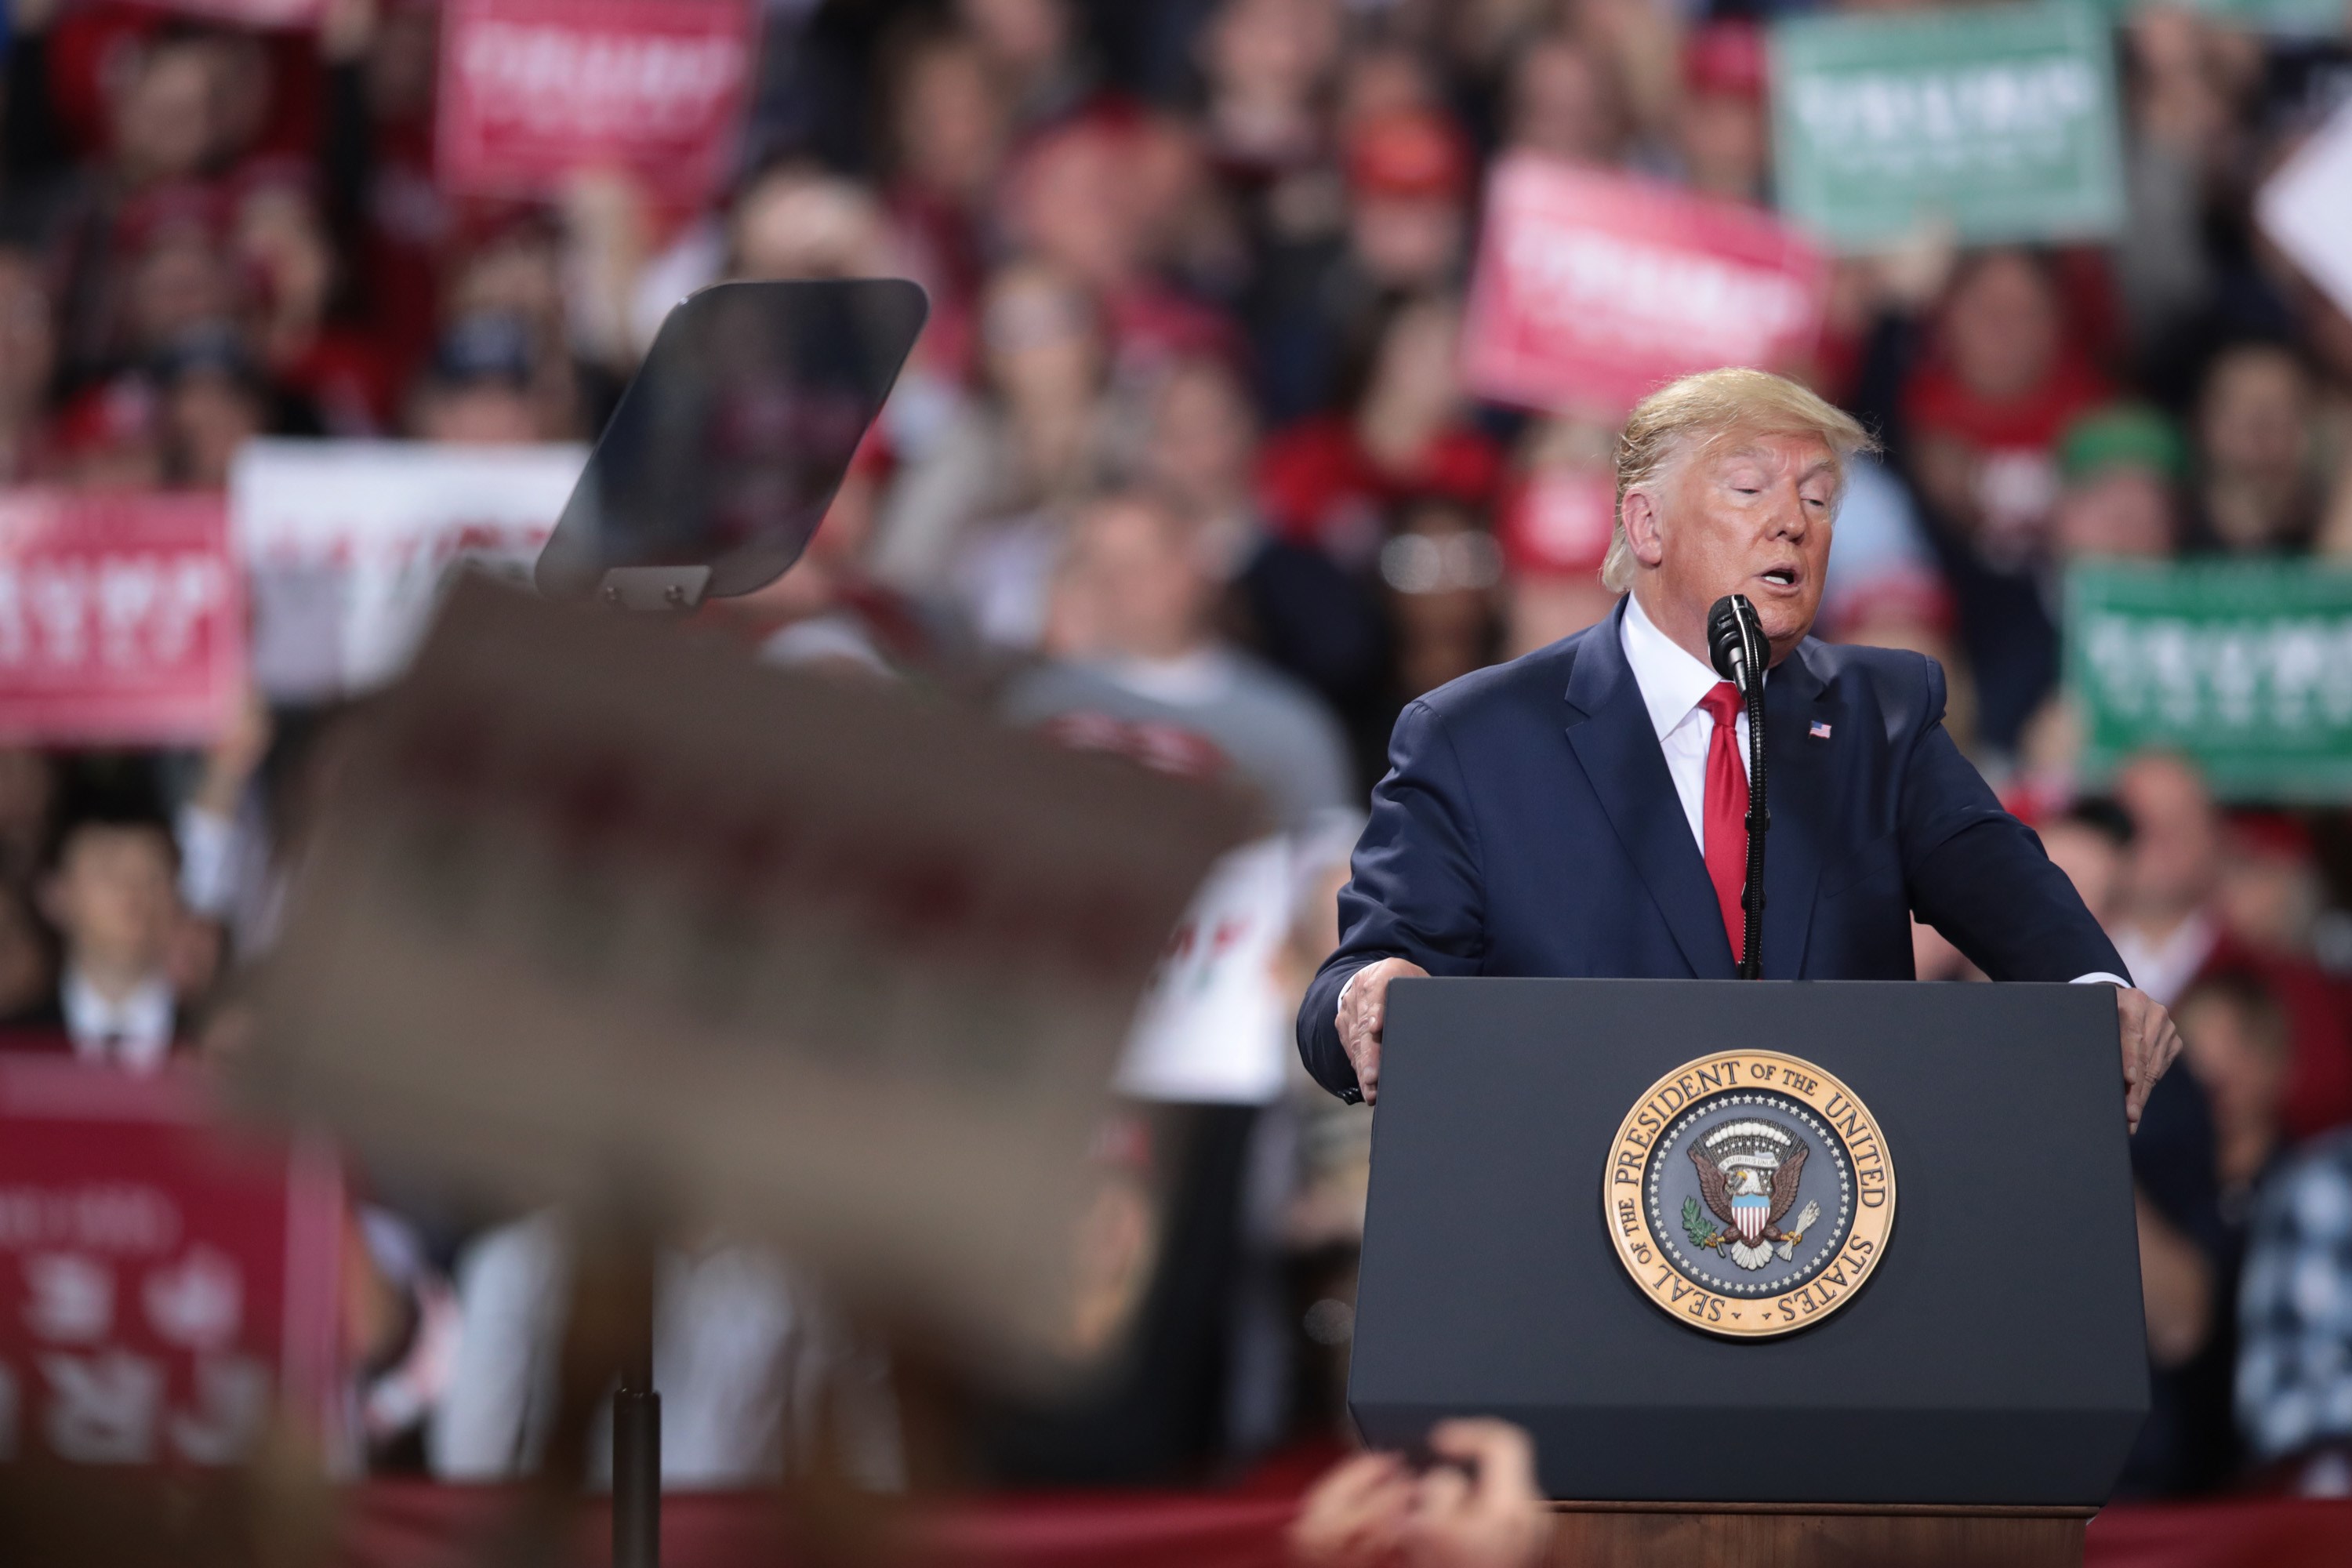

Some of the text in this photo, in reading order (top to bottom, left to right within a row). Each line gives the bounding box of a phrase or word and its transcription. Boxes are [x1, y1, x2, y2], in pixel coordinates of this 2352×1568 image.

[1615, 1060, 1886, 1322] SEAL OF THE PRESIDENT OF THE UNITED STATES
